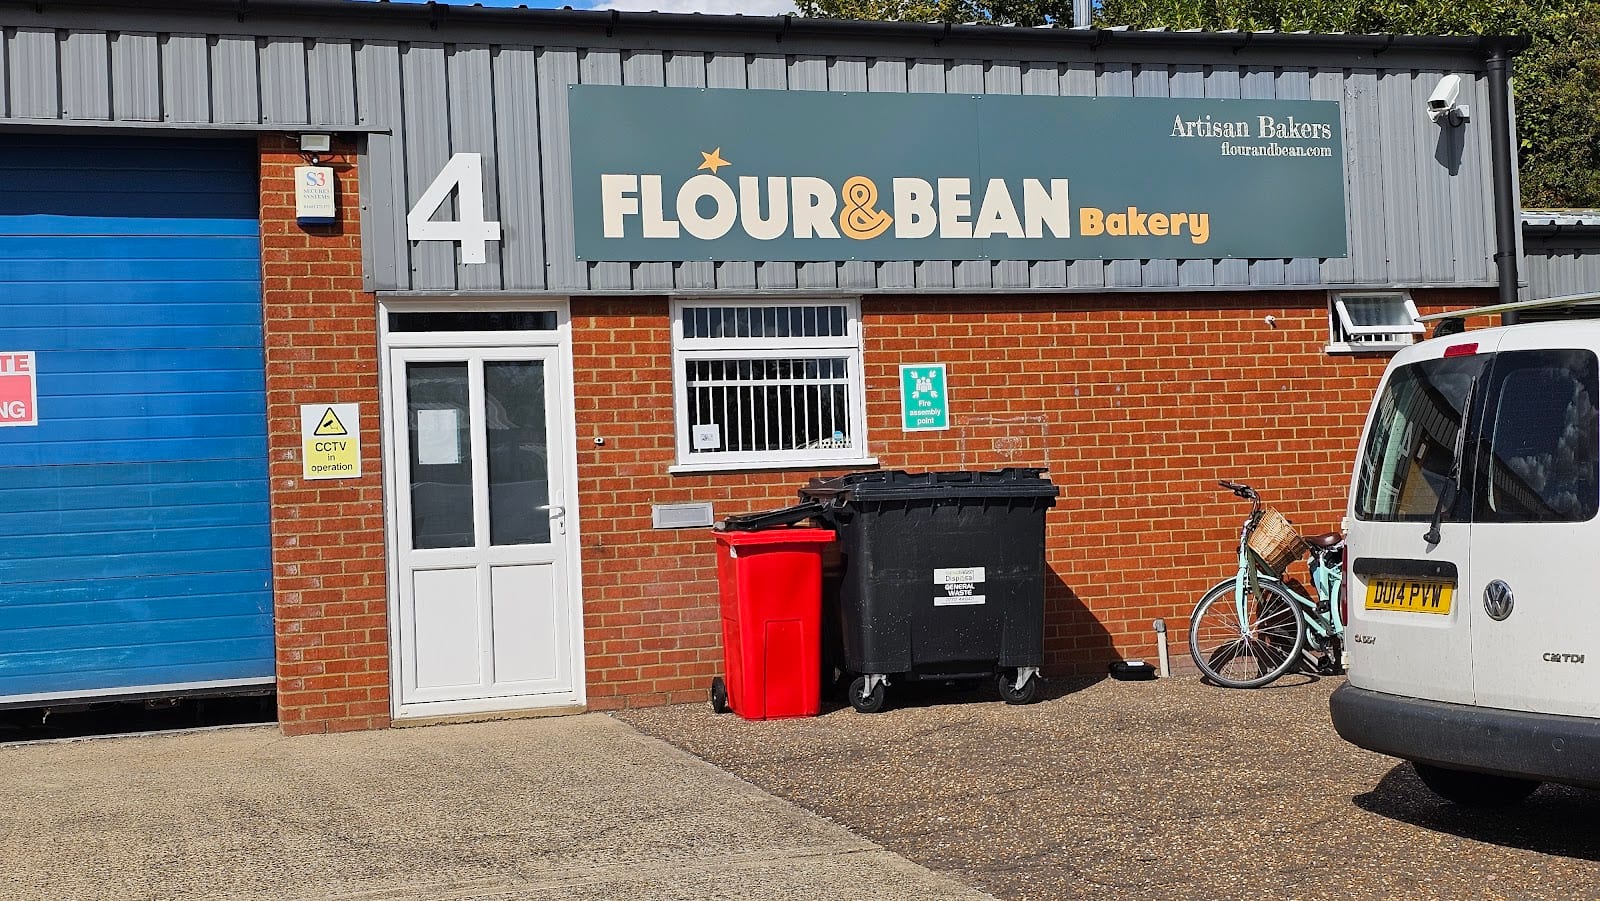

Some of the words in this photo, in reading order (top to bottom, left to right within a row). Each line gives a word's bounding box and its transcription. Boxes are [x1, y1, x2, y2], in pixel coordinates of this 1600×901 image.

[1169, 113, 1250, 138] Artisan
[1257, 115, 1332, 140] Bakers
[1221, 141, 1332, 157] flourandbean.com
[306, 171, 325, 187] S3
[407, 152, 501, 264] 4
[1079, 206, 1209, 245] Bakery
[918, 399, 932, 407] Fire
[909, 407, 941, 417] assembly
[917, 417, 935, 426] point
[315, 441, 347, 452] CCTV
[327, 453, 336, 462] in
[311, 463, 353, 473] operation
[1373, 581, 1406, 605] DU14
[1408, 583, 1443, 608] PVW
